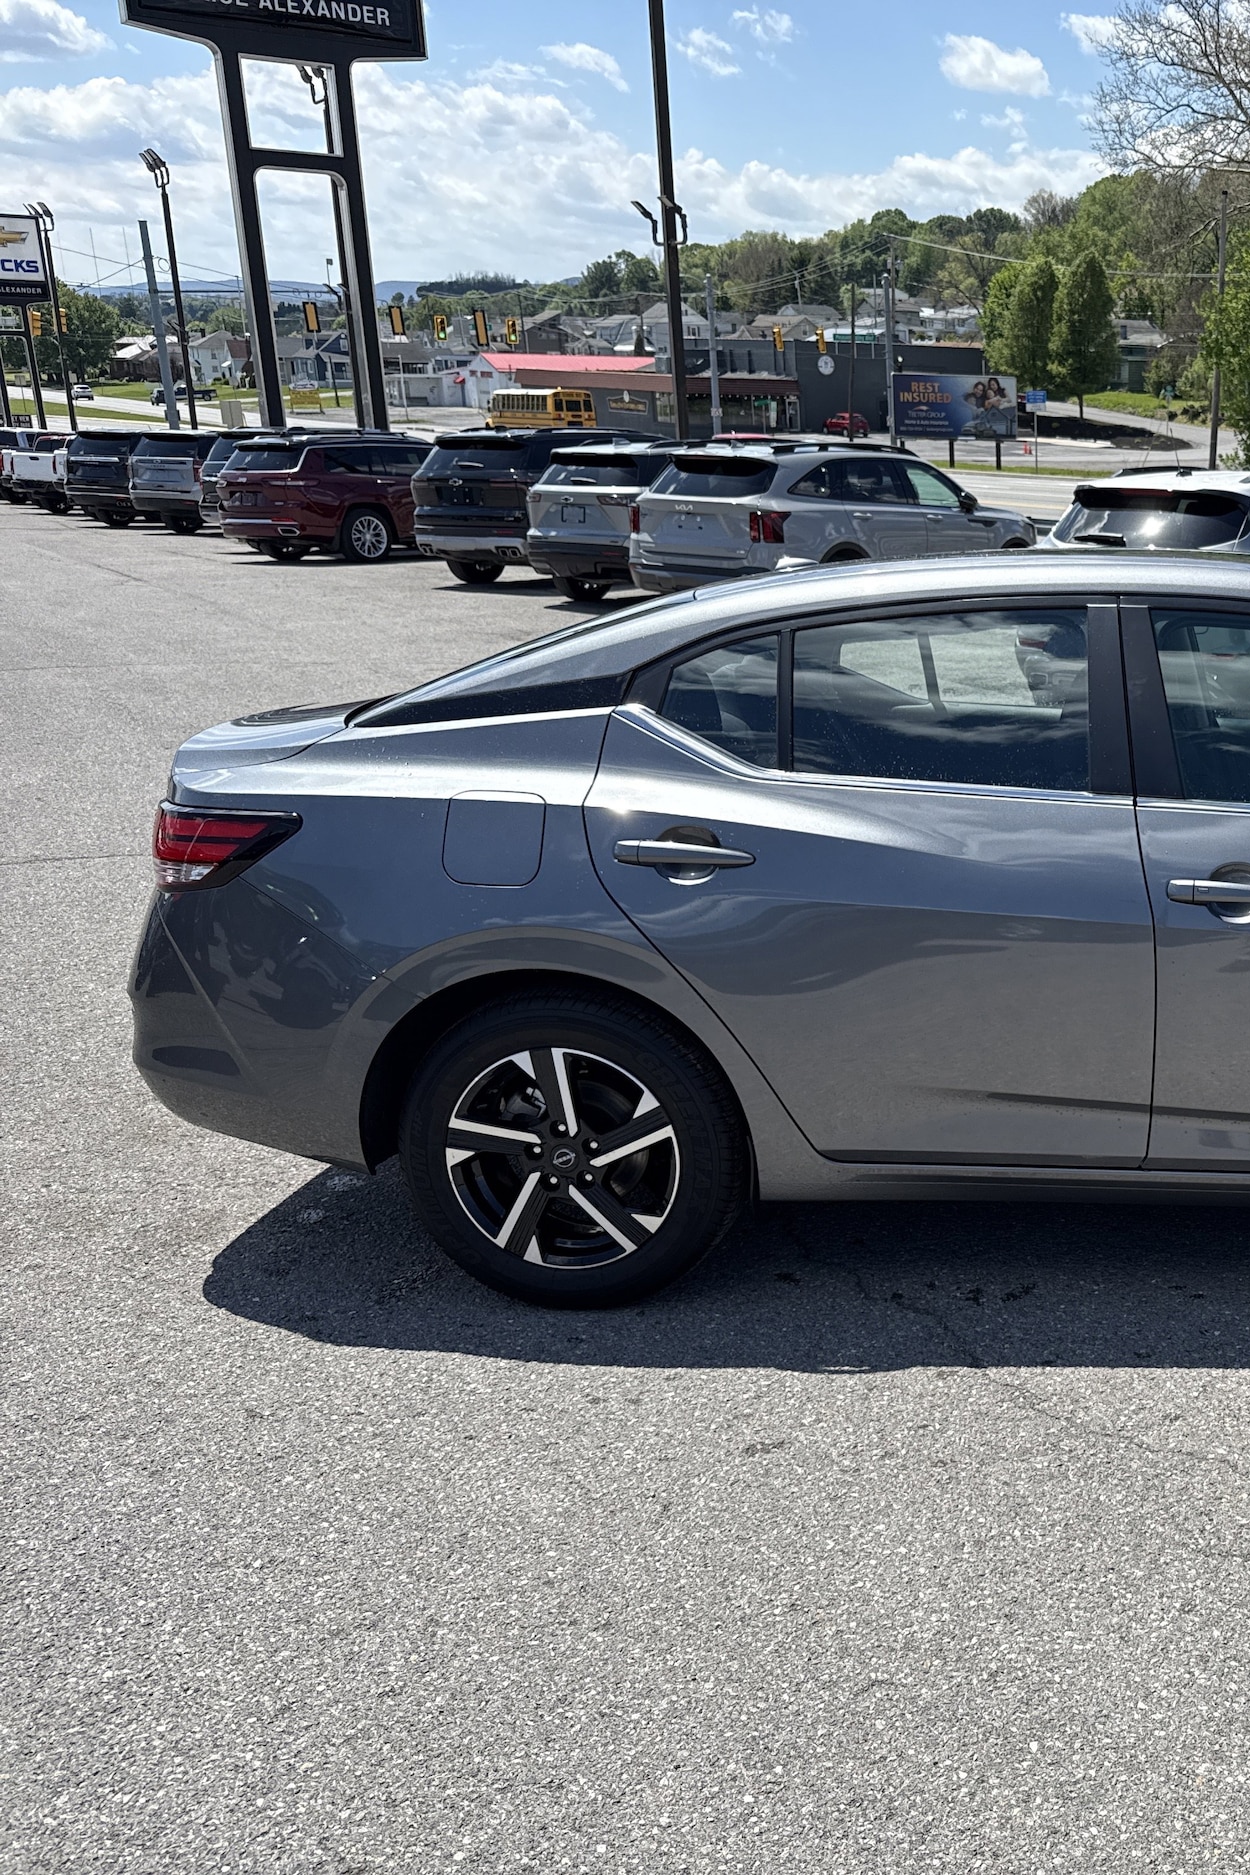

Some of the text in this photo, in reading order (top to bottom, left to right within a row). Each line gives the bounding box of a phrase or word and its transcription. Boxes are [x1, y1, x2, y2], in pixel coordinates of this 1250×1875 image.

[259, 0, 390, 26] ALEXANDER
[911, 382, 940, 392] REST
[900, 392, 952, 403] INSURED
